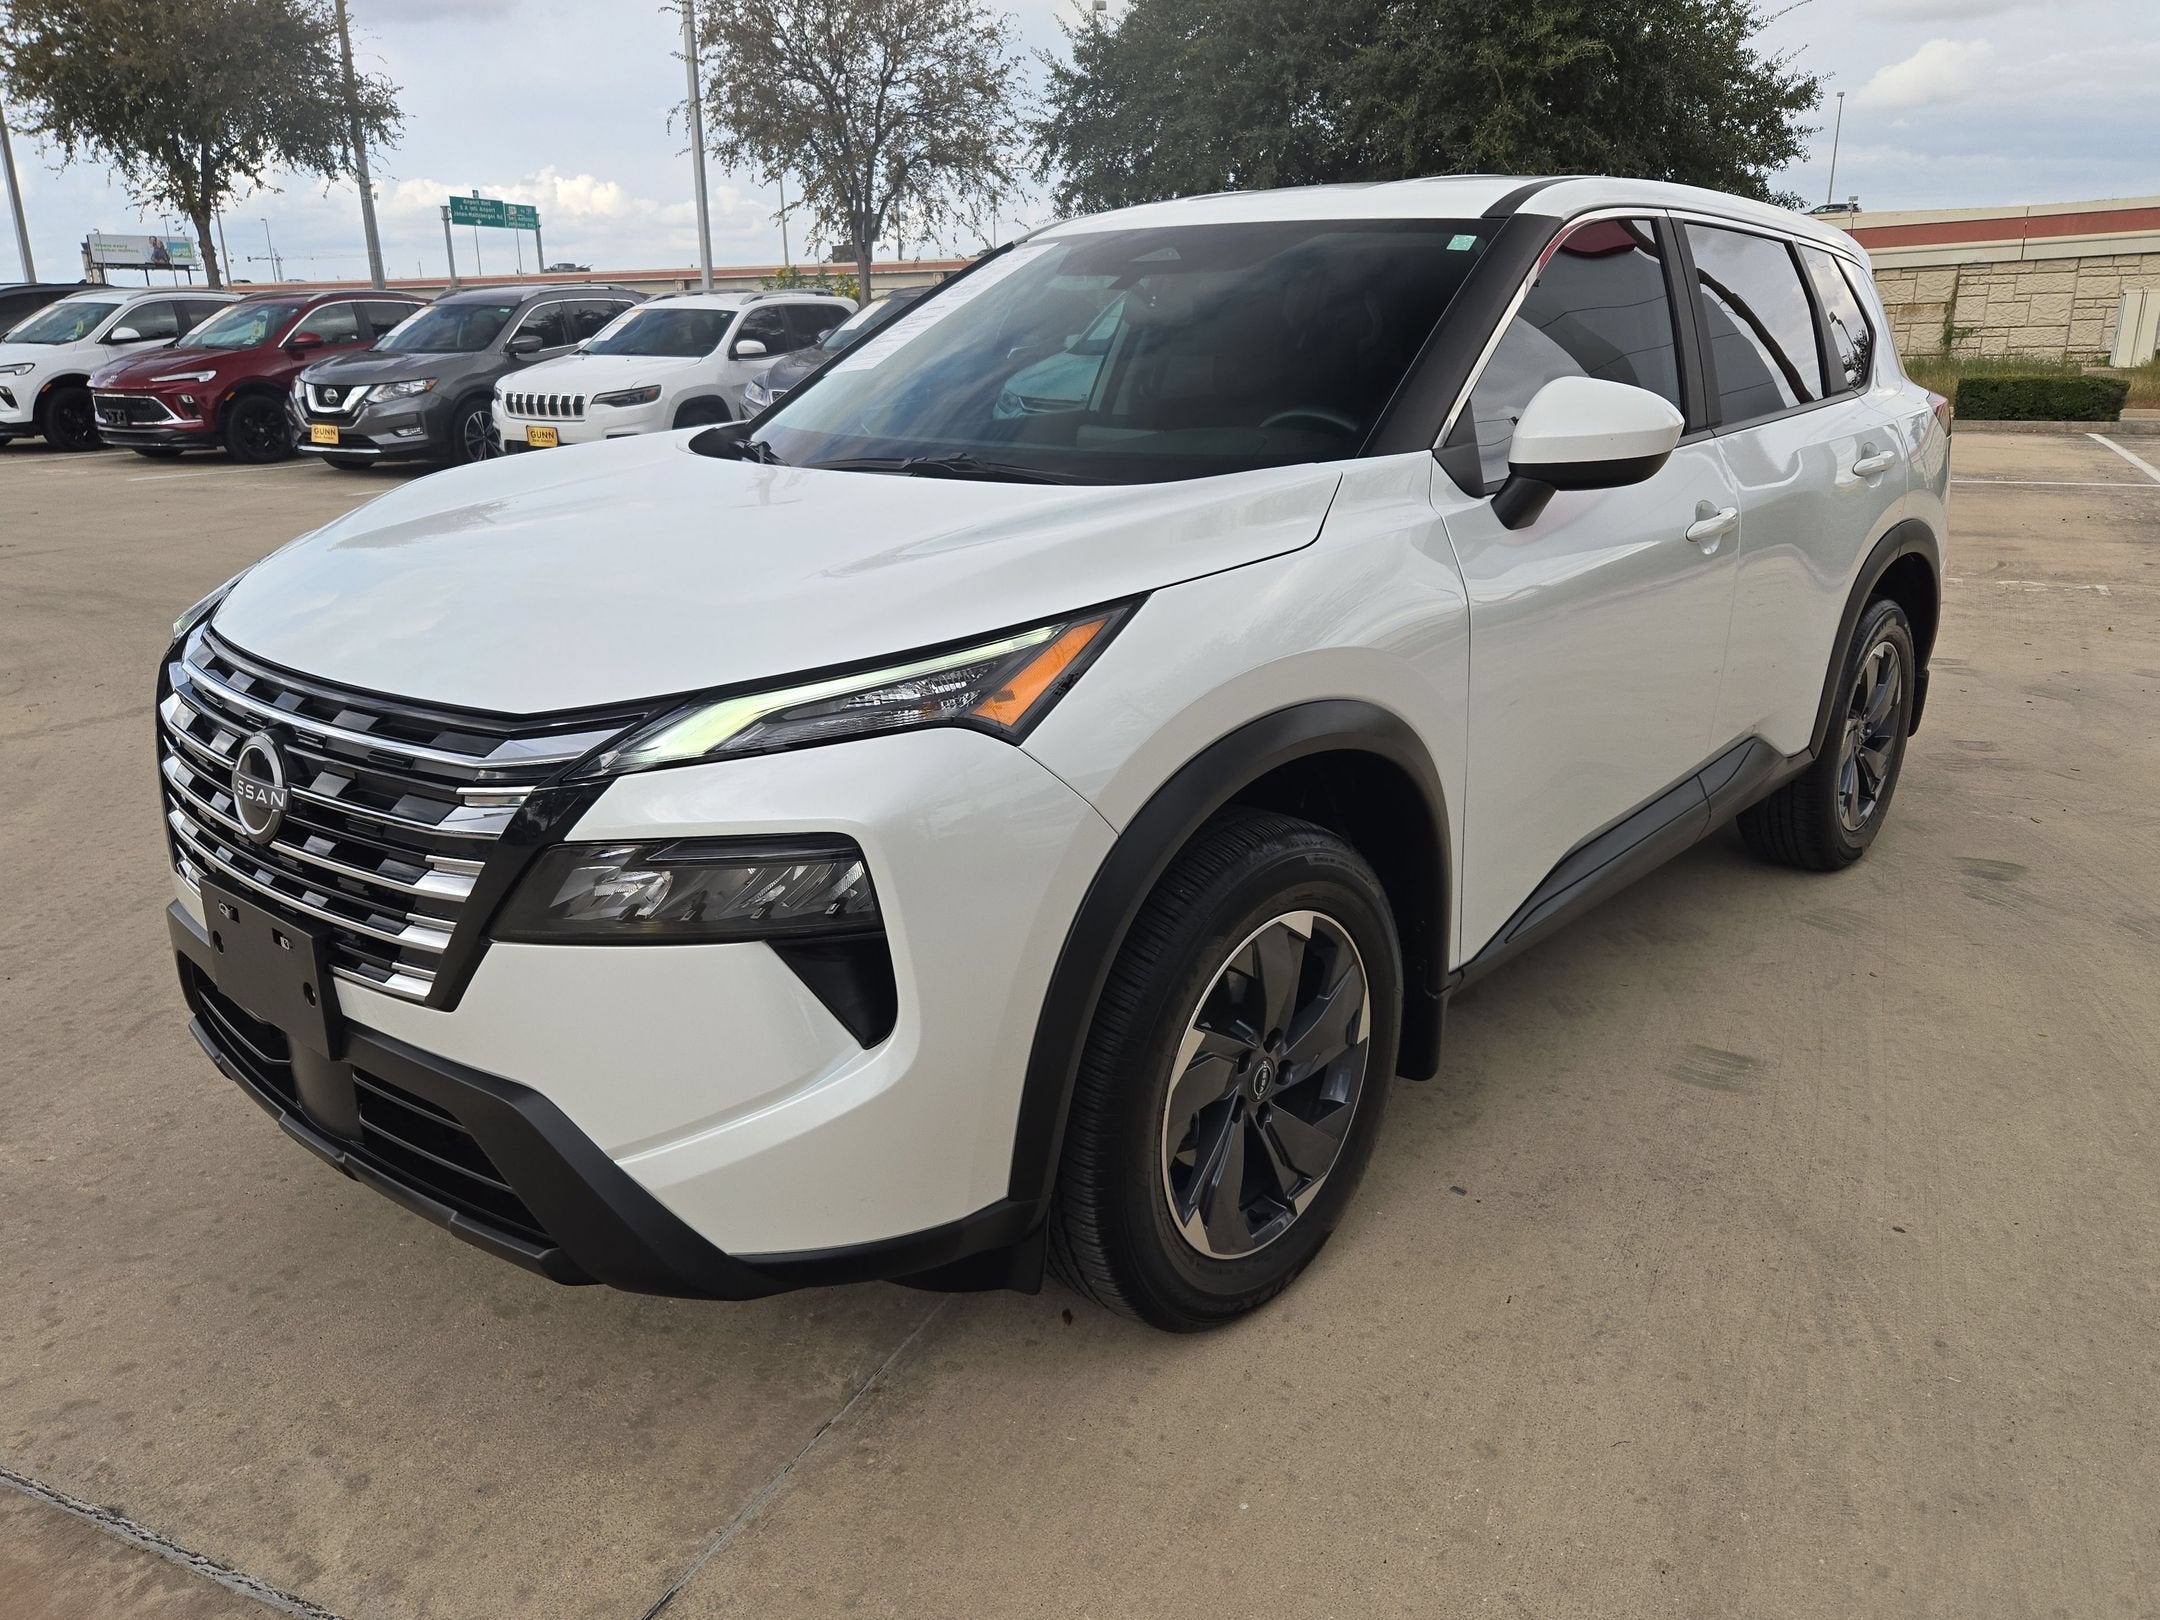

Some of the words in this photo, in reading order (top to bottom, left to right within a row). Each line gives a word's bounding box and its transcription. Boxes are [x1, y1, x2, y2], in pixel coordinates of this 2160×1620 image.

[313, 427, 336, 436] GUNN
[530, 430, 554, 439] GUNN
[237, 779, 284, 807] SSAN
